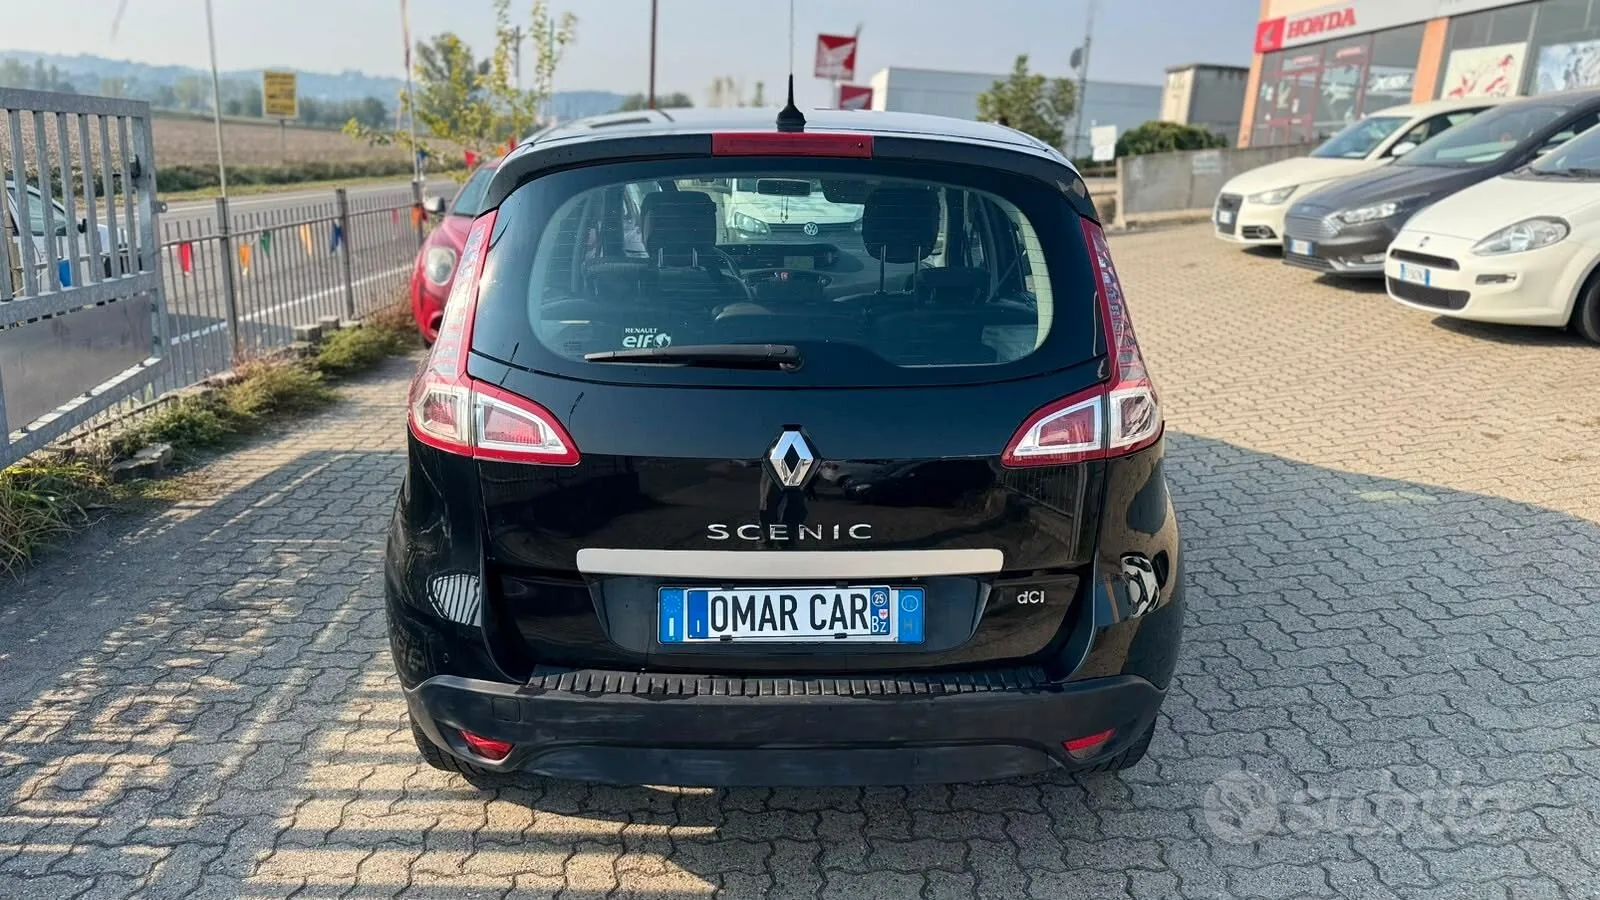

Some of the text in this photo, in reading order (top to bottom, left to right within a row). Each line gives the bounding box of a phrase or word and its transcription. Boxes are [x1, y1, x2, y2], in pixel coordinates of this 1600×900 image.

[1287, 8, 1356, 38] HONDA
[622, 335, 653, 348] elf
[707, 524, 872, 540] SCENIC
[874, 594, 884, 604] 25
[710, 595, 799, 632] OMAR
[809, 593, 869, 631] CAR
